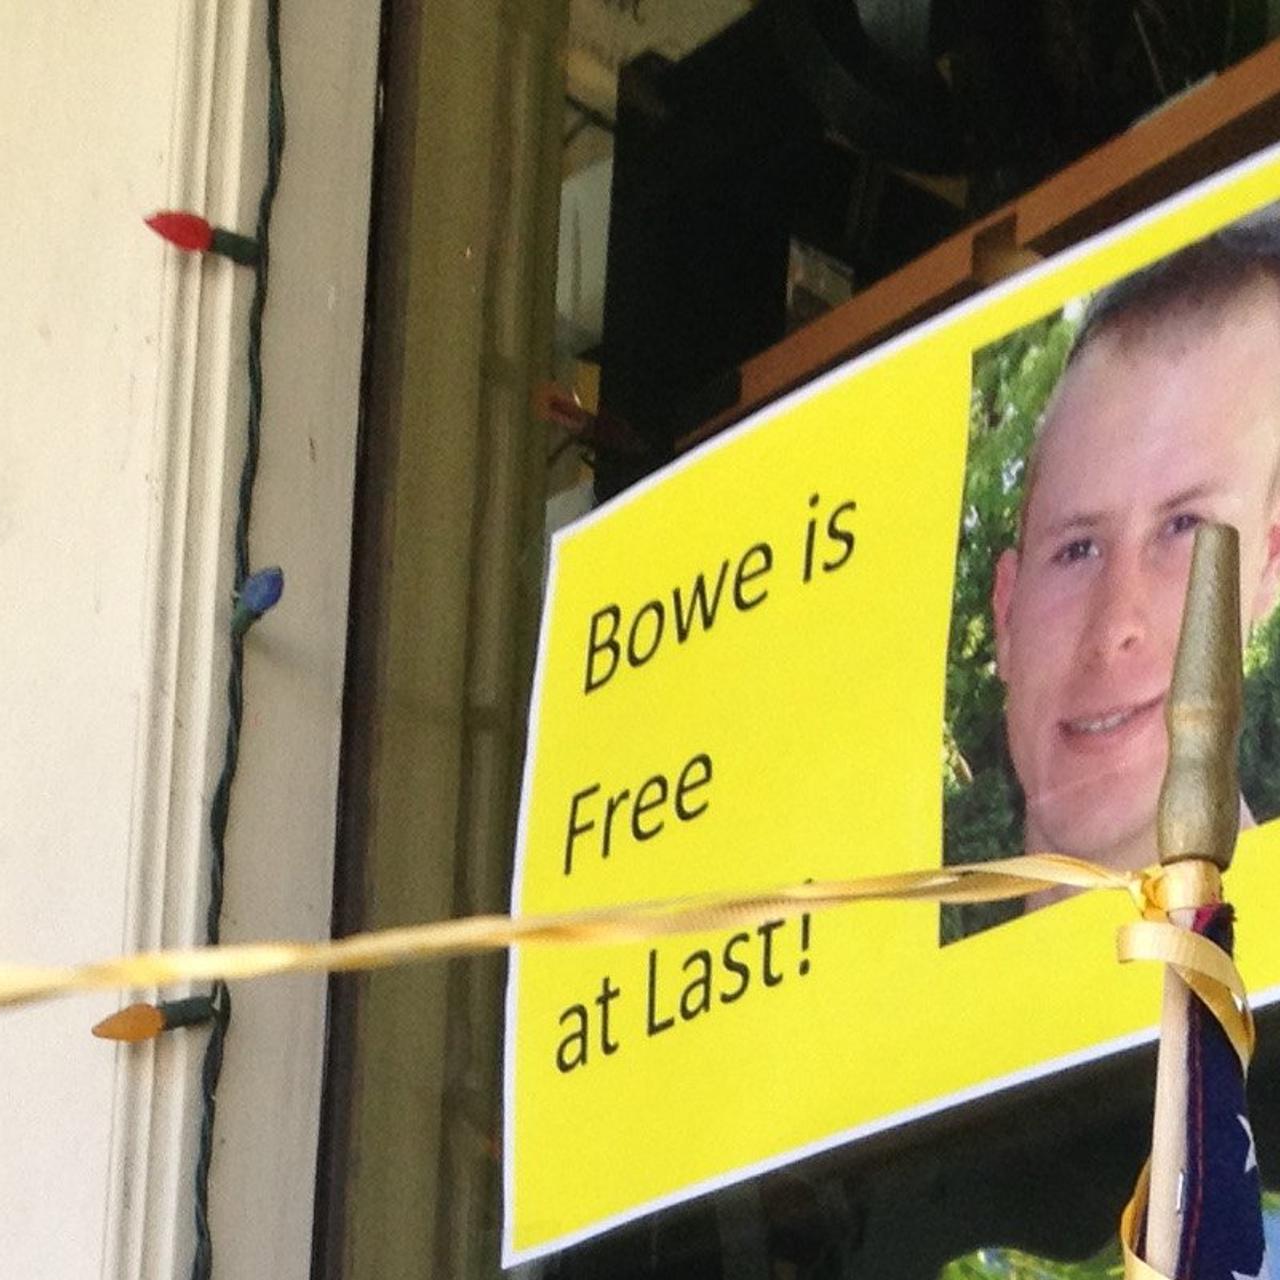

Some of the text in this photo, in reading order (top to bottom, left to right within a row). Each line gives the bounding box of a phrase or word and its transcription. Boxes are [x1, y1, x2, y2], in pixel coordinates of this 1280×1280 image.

[583, 489, 860, 697] Bowe is
[563, 748, 715, 877] Free
[554, 878, 817, 1076] at Last!
